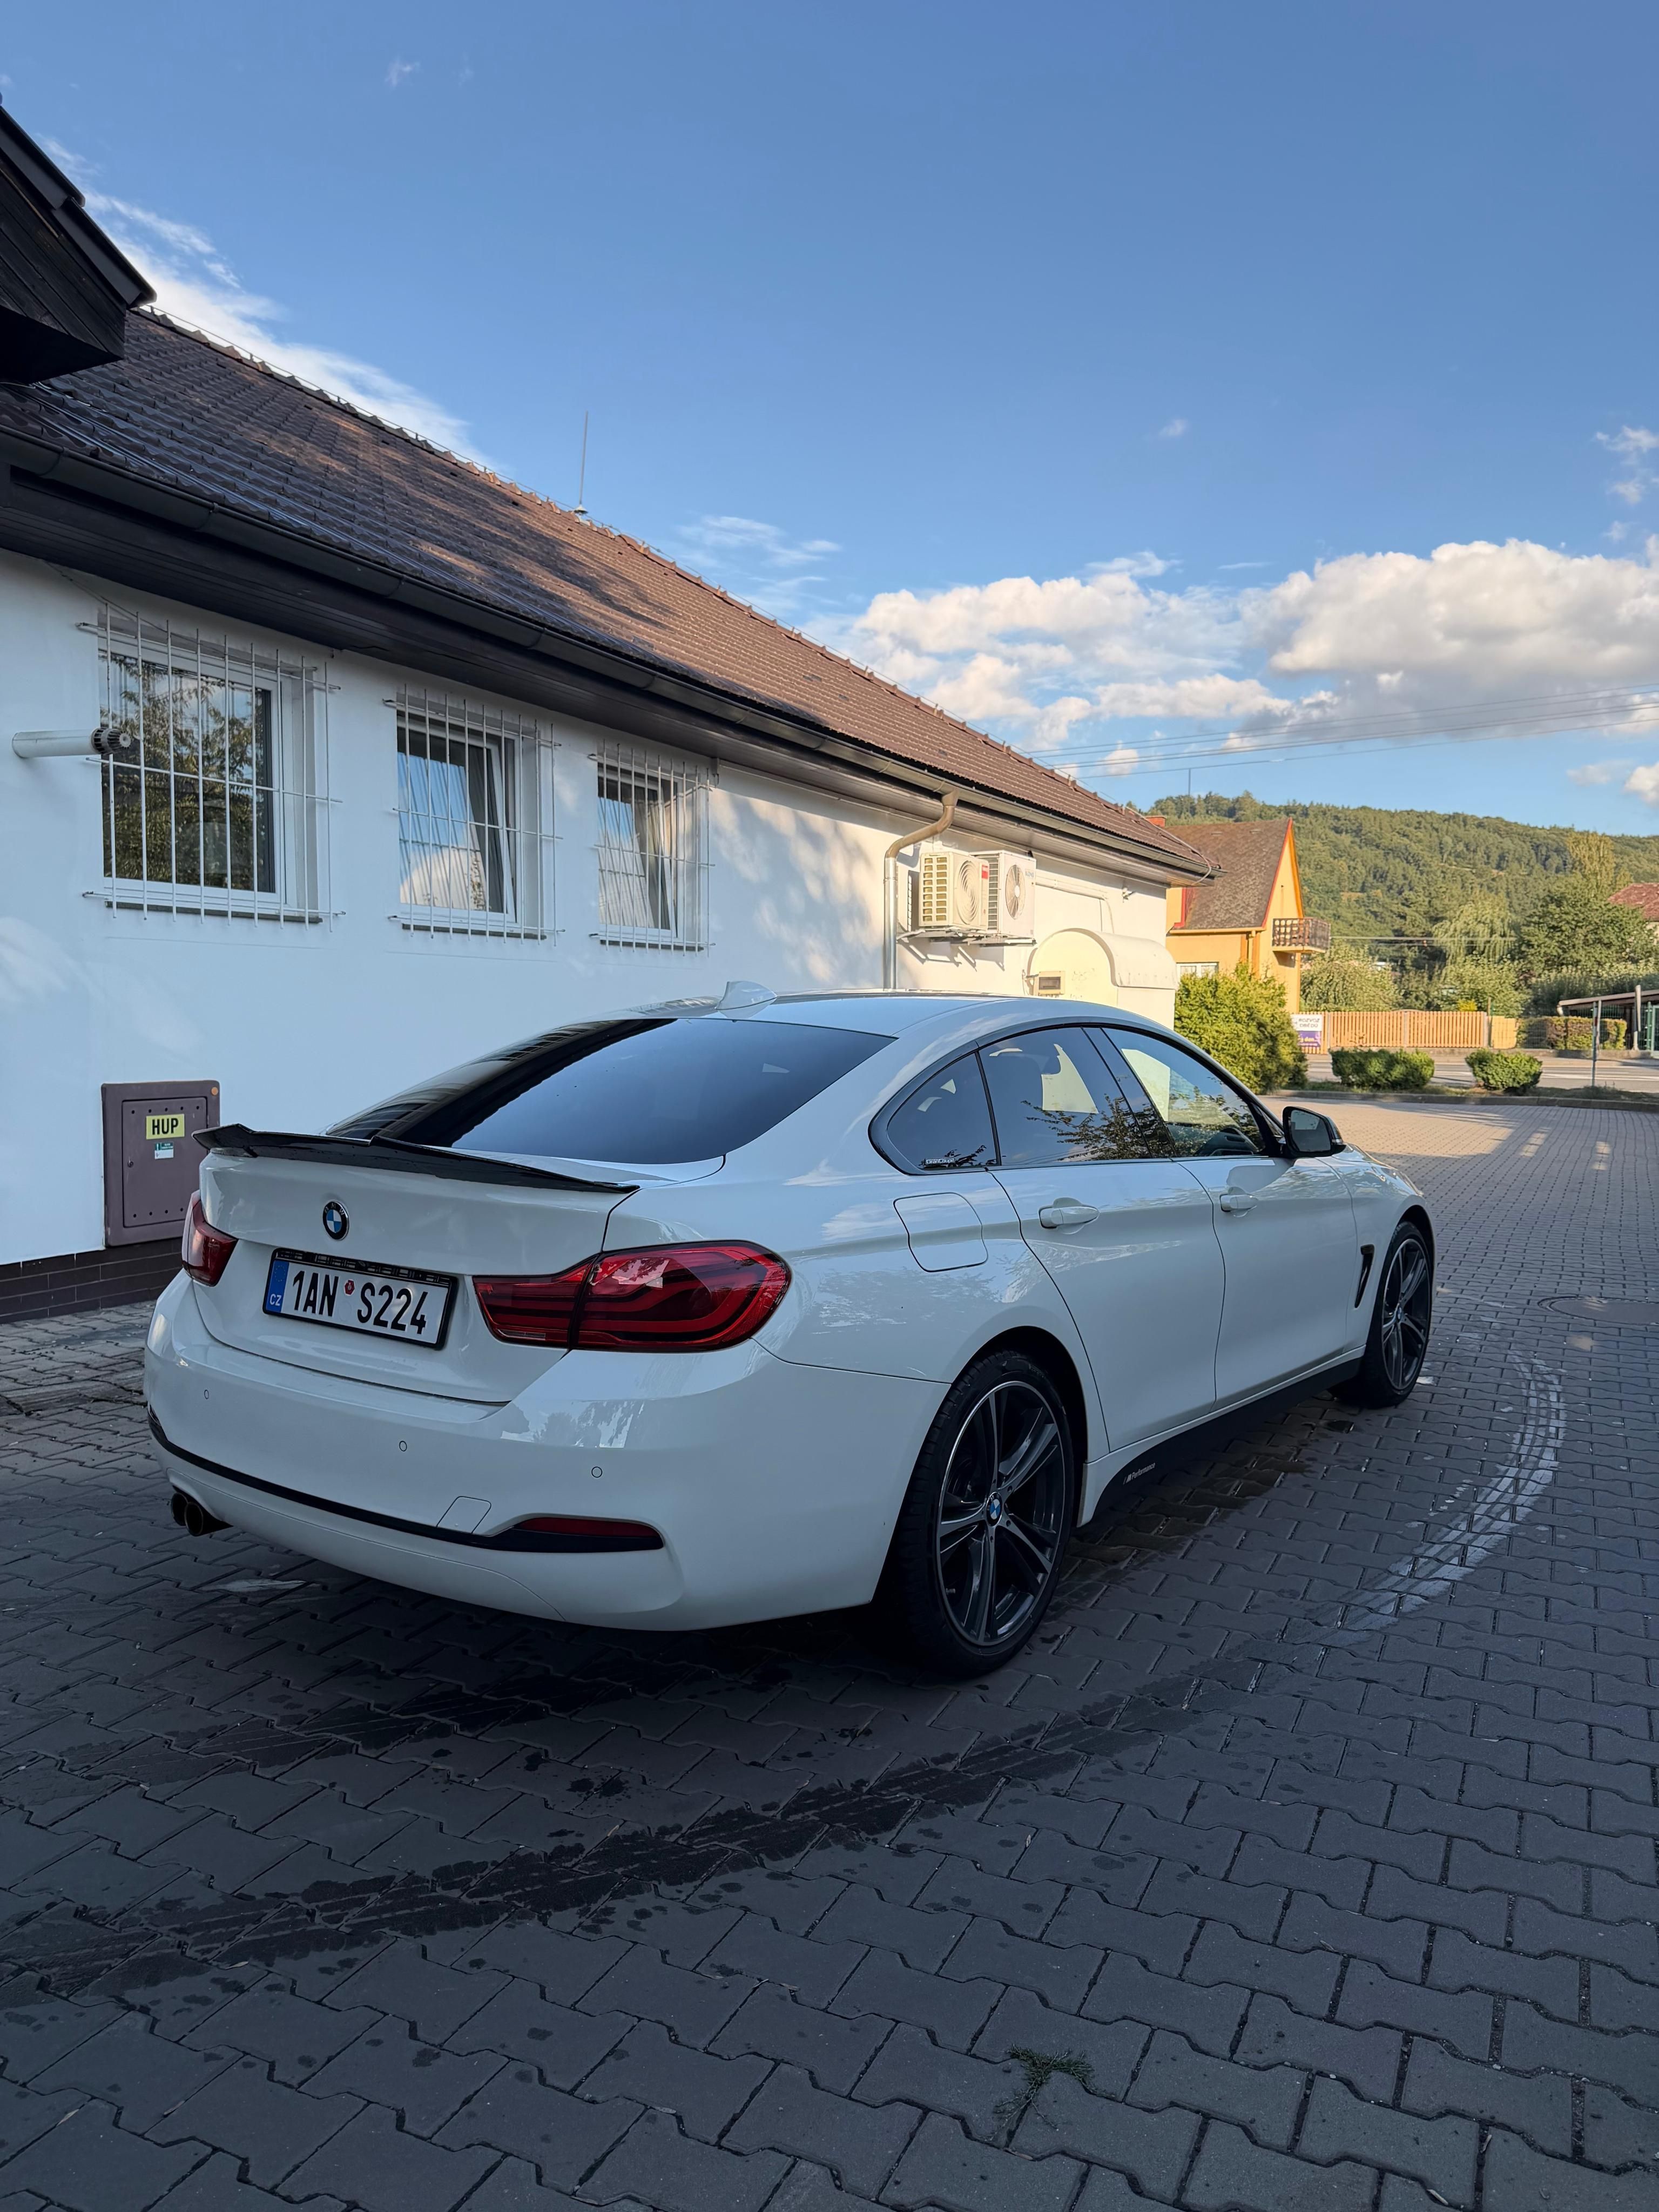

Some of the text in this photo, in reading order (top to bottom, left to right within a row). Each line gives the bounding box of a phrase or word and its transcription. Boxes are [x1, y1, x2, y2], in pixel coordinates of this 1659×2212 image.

[152, 1118, 179, 1135] HUP
[269, 1293, 282, 1307] CZ
[292, 1270, 429, 1335] 1AN S224
